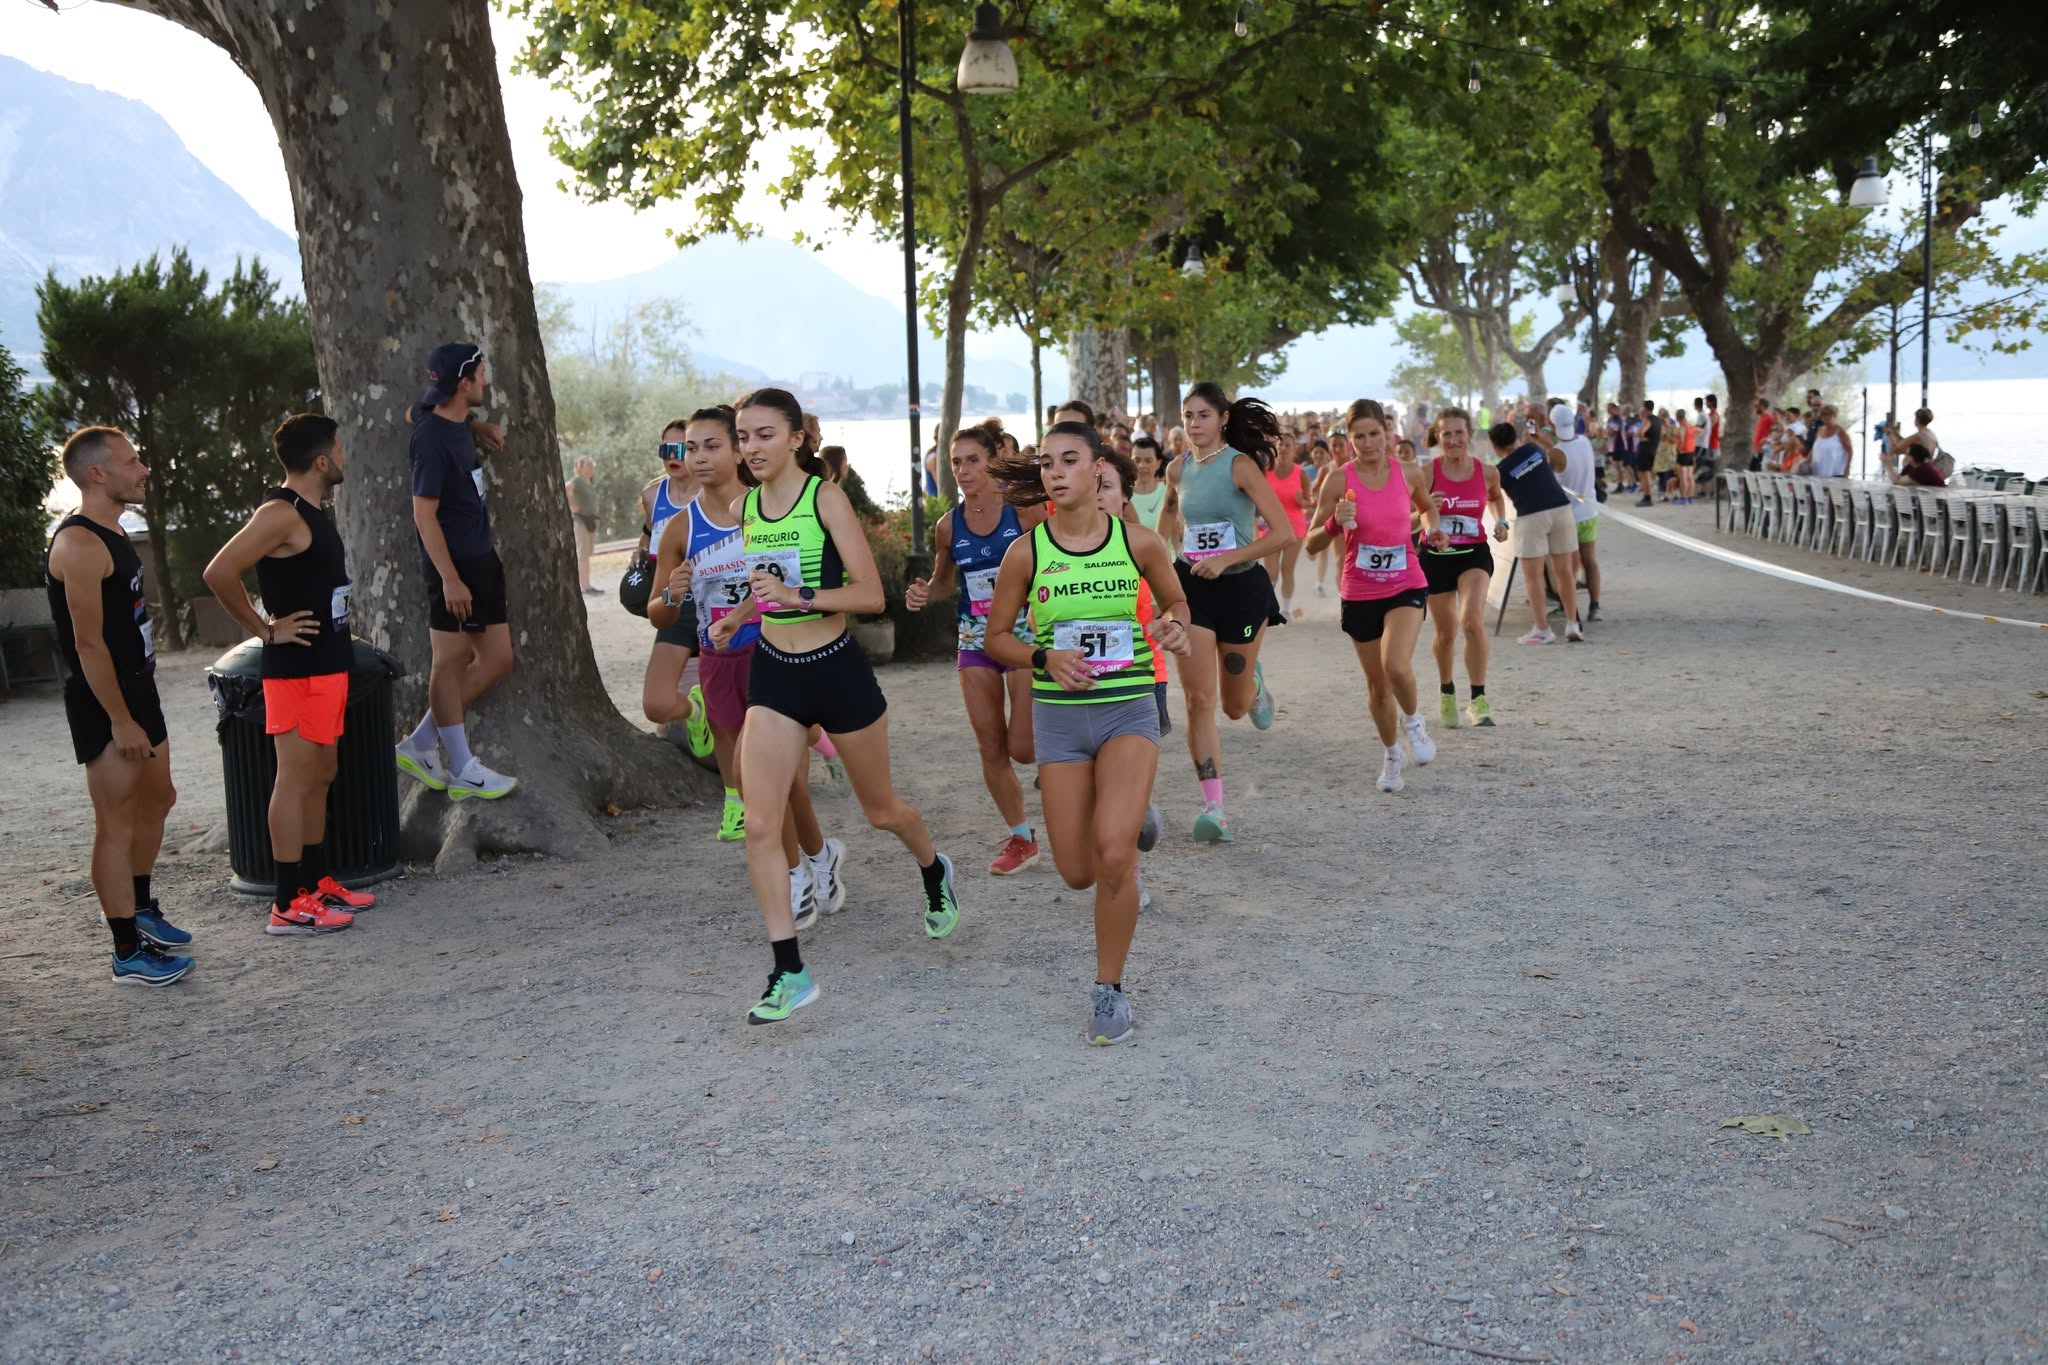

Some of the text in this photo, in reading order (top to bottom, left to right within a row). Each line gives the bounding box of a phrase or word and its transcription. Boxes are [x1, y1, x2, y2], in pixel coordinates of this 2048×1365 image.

[750, 531, 800, 544] MERCURIO
[1198, 532, 1220, 550] 55
[1084, 560, 1128, 569] SALOMON
[1370, 553, 1393, 569] 97
[724, 581, 752, 605] 32
[1054, 579, 1138, 597] MERCURIO
[1080, 633, 1106, 657] 51
